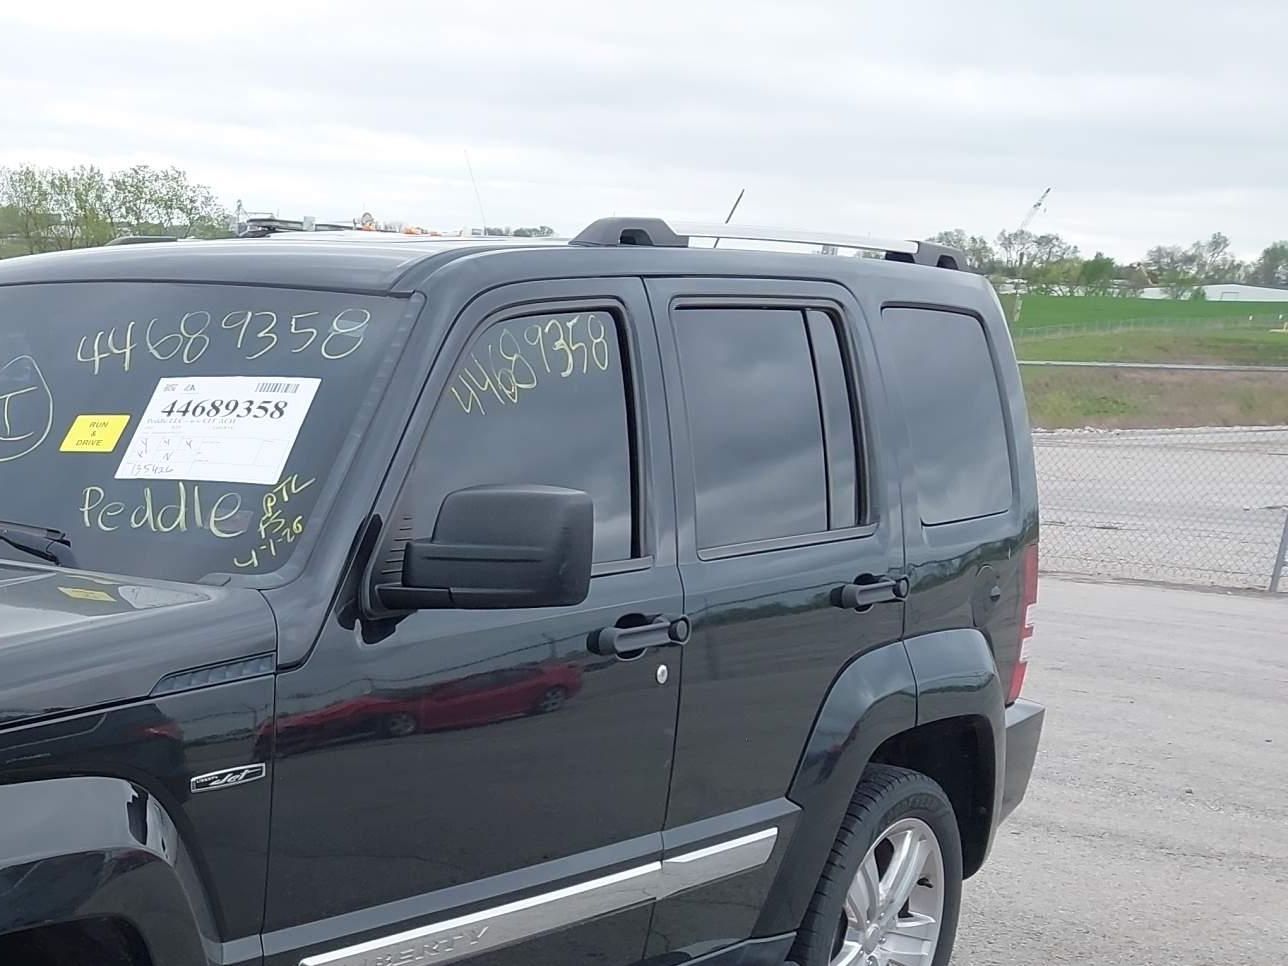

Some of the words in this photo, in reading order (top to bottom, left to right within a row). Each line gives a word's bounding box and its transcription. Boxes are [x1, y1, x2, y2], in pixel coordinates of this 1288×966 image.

[77, 308, 371, 375] 44689358
[450, 314, 608, 416] 44689358
[161, 399, 288, 420] 44689358
[78, 486, 244, 537] Peddle
[208, 767, 262, 786] Jet
